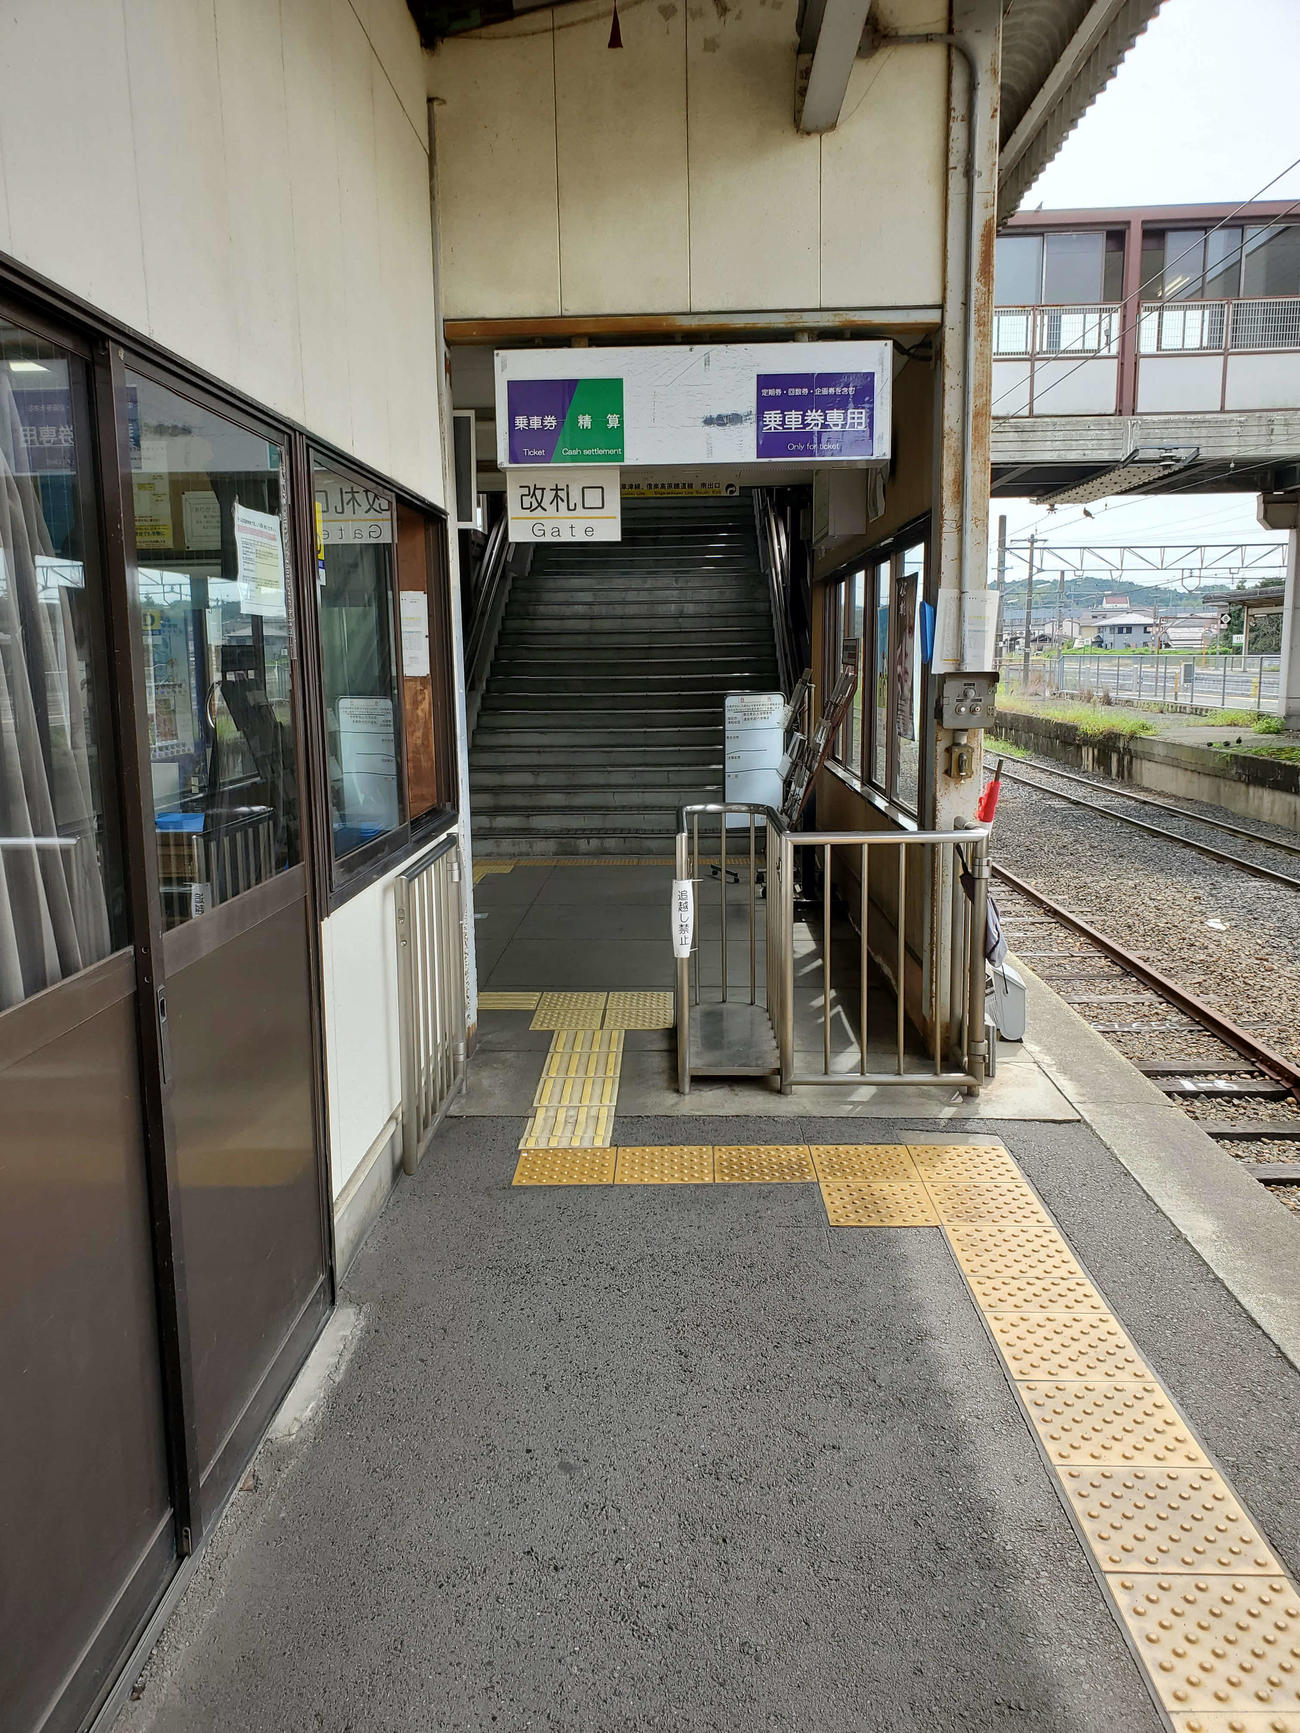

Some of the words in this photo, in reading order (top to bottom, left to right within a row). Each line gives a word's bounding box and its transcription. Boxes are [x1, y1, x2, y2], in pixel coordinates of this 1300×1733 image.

[514, 414, 558, 431] 乗車券
[762, 408, 867, 431] 乗車券専用
[523, 448, 546, 457] Ticket
[562, 447, 581, 456] Cash
[583, 447, 622, 456] settlement
[787, 442, 805, 451] Only
[806, 442, 817, 450] for
[819, 441, 840, 450] ticket
[519, 484, 606, 513] 改札口
[531, 522, 595, 538] Gate
[677, 889, 690, 946] 追越し禁止
